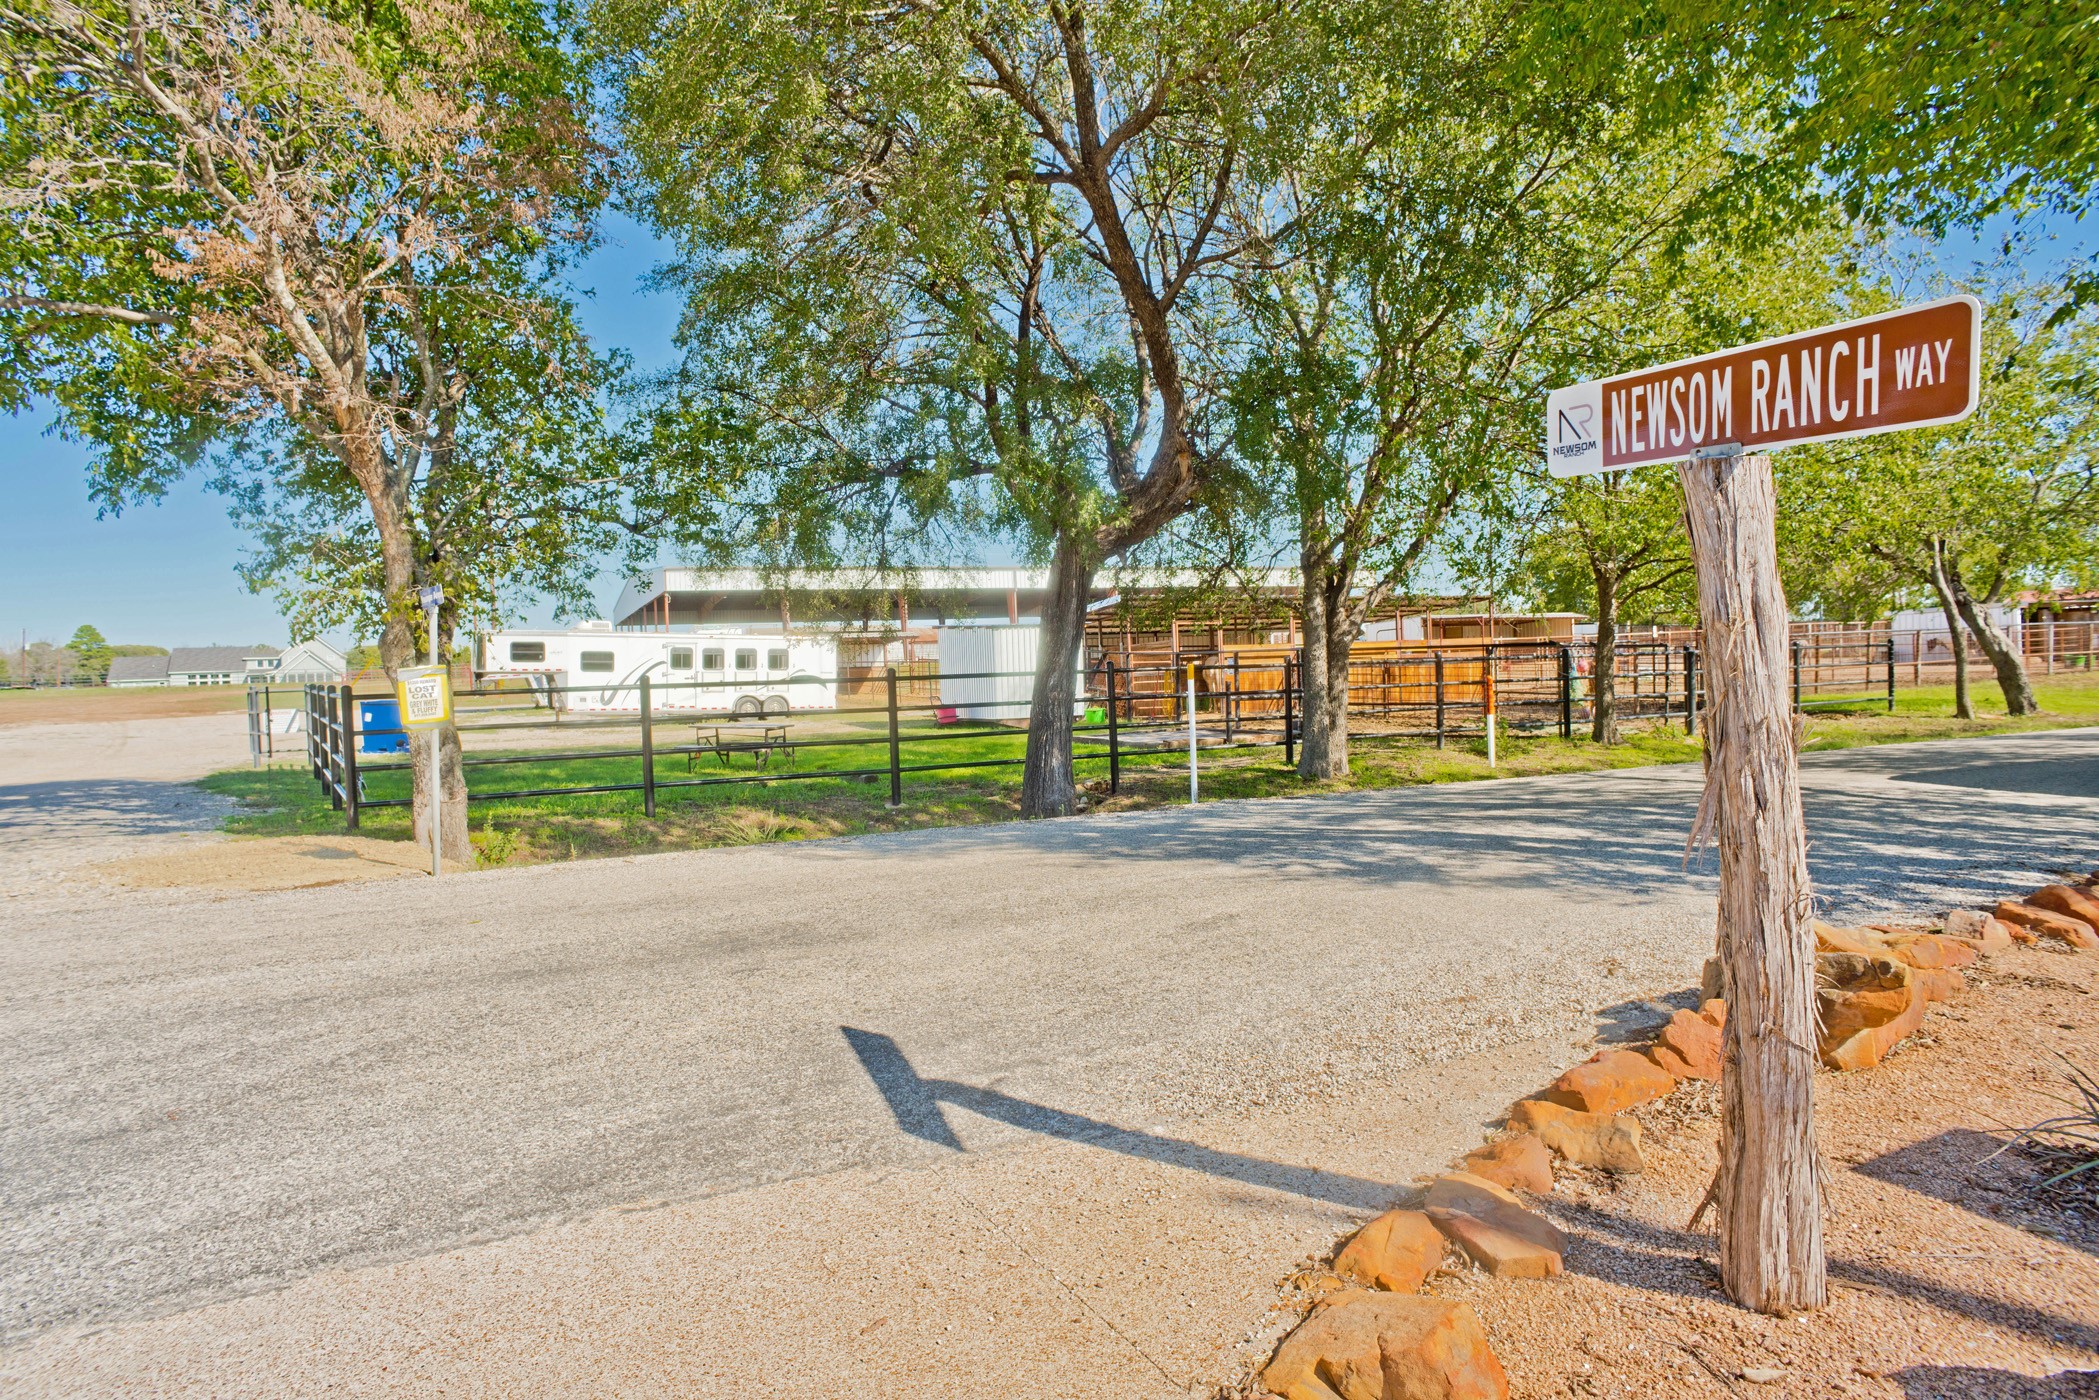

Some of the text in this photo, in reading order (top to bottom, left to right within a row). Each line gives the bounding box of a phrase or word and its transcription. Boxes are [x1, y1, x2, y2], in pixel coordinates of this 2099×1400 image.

[1611, 333, 1953, 456] NEWSOM RANCH WAY
[1552, 440, 1597, 456] NEWSOM
[408, 684, 436, 694] LOST
[411, 691, 435, 700] CAT
[409, 698, 439, 709] GREY WHITE
[417, 705, 438, 714] FLUFFY
